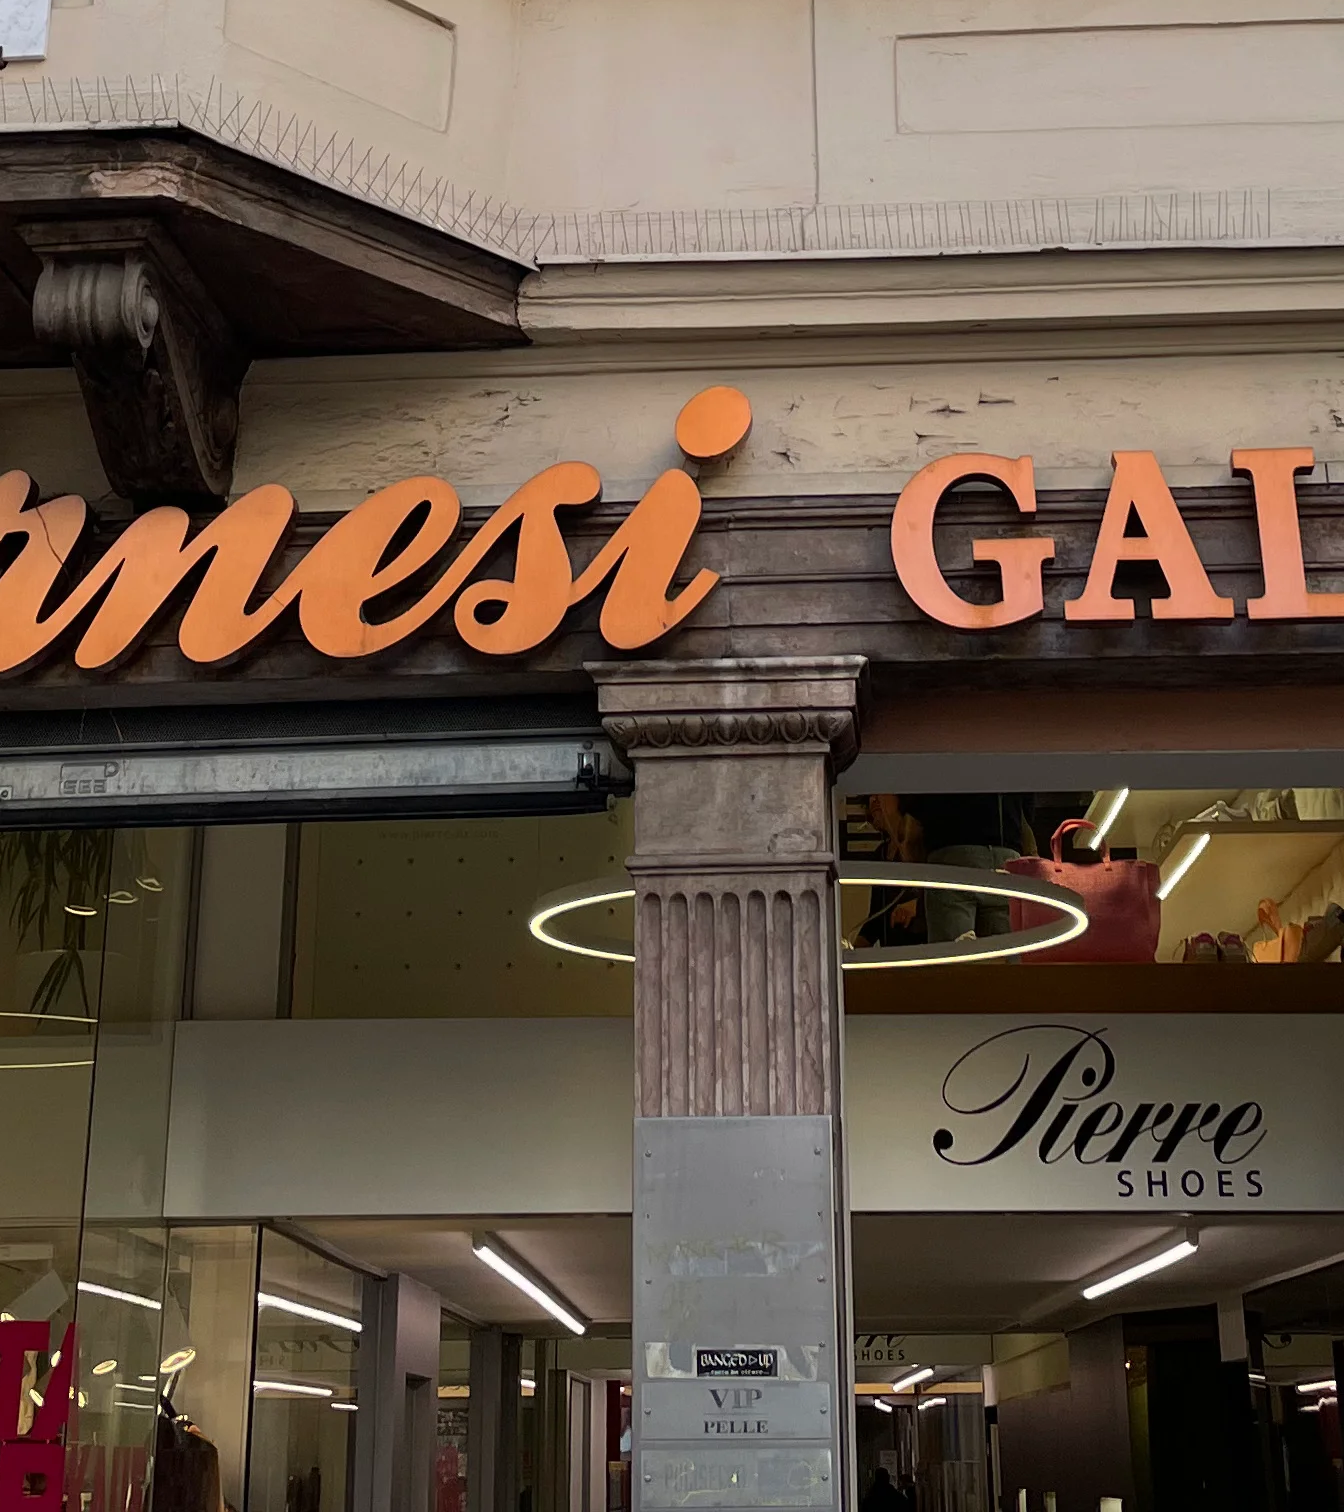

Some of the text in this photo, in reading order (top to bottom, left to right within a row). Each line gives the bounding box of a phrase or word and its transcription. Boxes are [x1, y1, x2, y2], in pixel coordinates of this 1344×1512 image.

[932, 1023, 1269, 1166] Pierre
[1116, 1169, 1265, 1199] SHOES
[854, 1349, 906, 1361] HOES
[708, 1388, 763, 1409] VIP
[703, 1420, 769, 1434] PELLE
